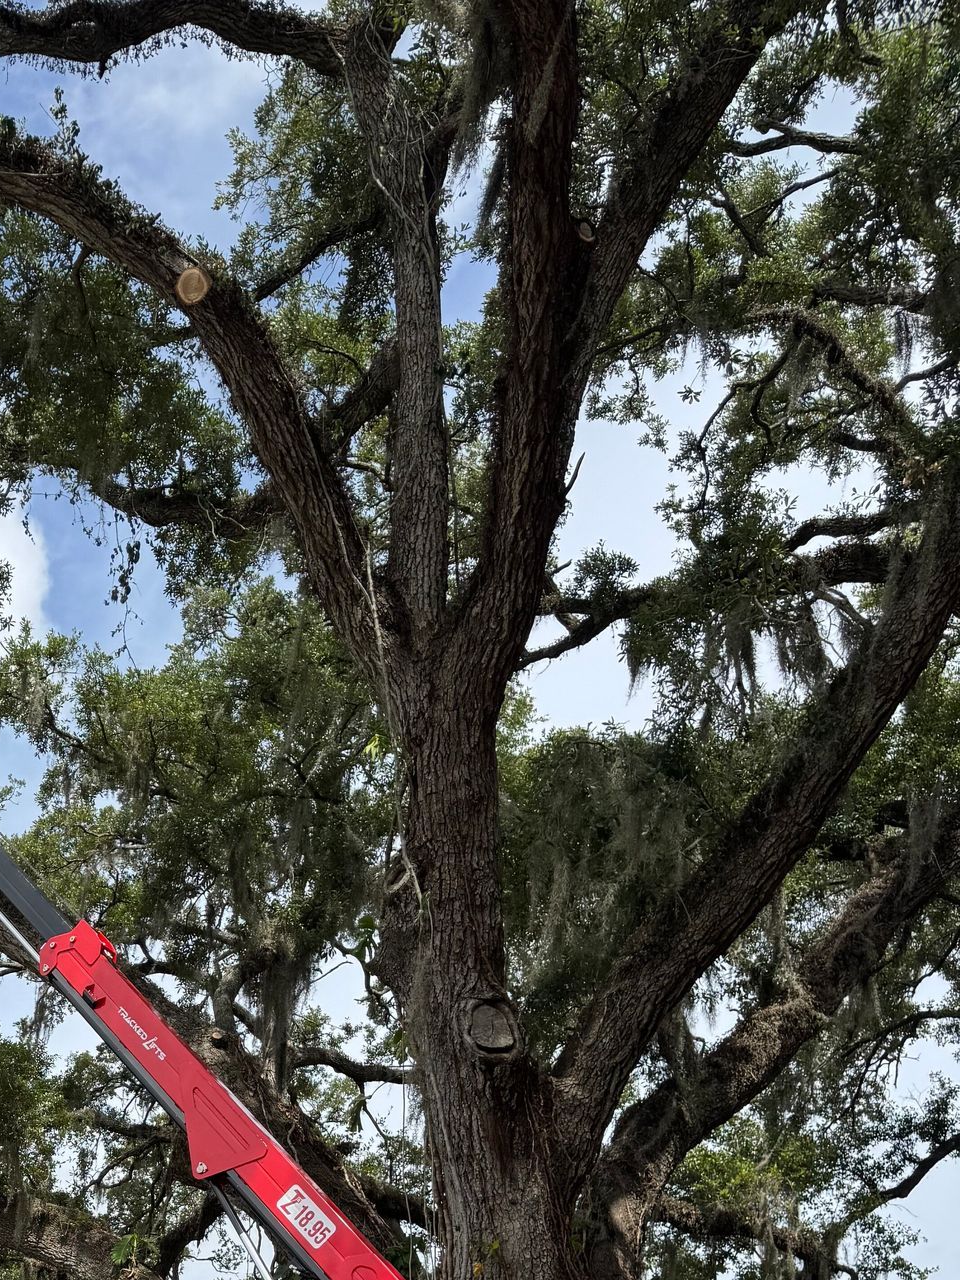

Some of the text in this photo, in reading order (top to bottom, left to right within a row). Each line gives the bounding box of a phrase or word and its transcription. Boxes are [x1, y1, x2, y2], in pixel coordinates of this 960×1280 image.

[118, 1006, 166, 1061] TRACKED LIFTS
[294, 1205, 331, 1245] 18.95
